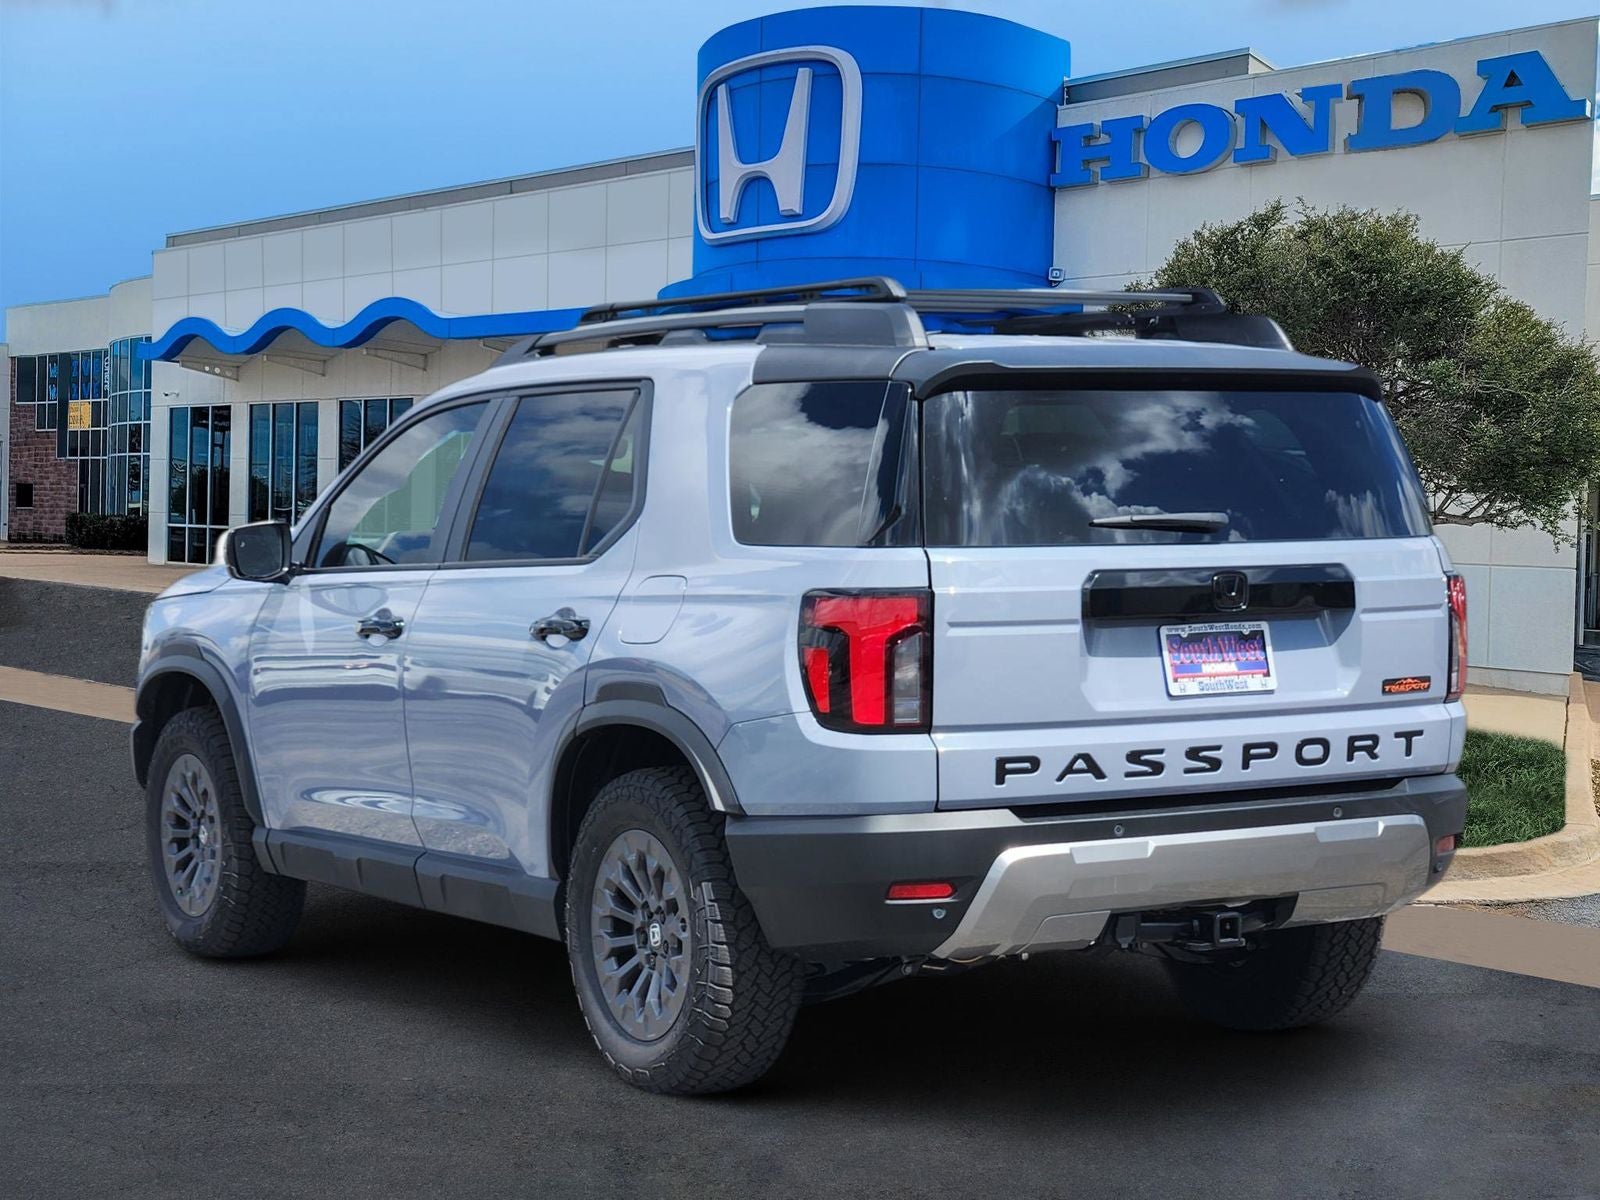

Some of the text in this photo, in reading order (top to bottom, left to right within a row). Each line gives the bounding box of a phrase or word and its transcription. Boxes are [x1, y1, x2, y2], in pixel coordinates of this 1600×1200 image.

[1050, 50, 1592, 188] HONDA
[1198, 679, 1248, 692] SouthWest
[995, 729, 1424, 786] PASSPORT
